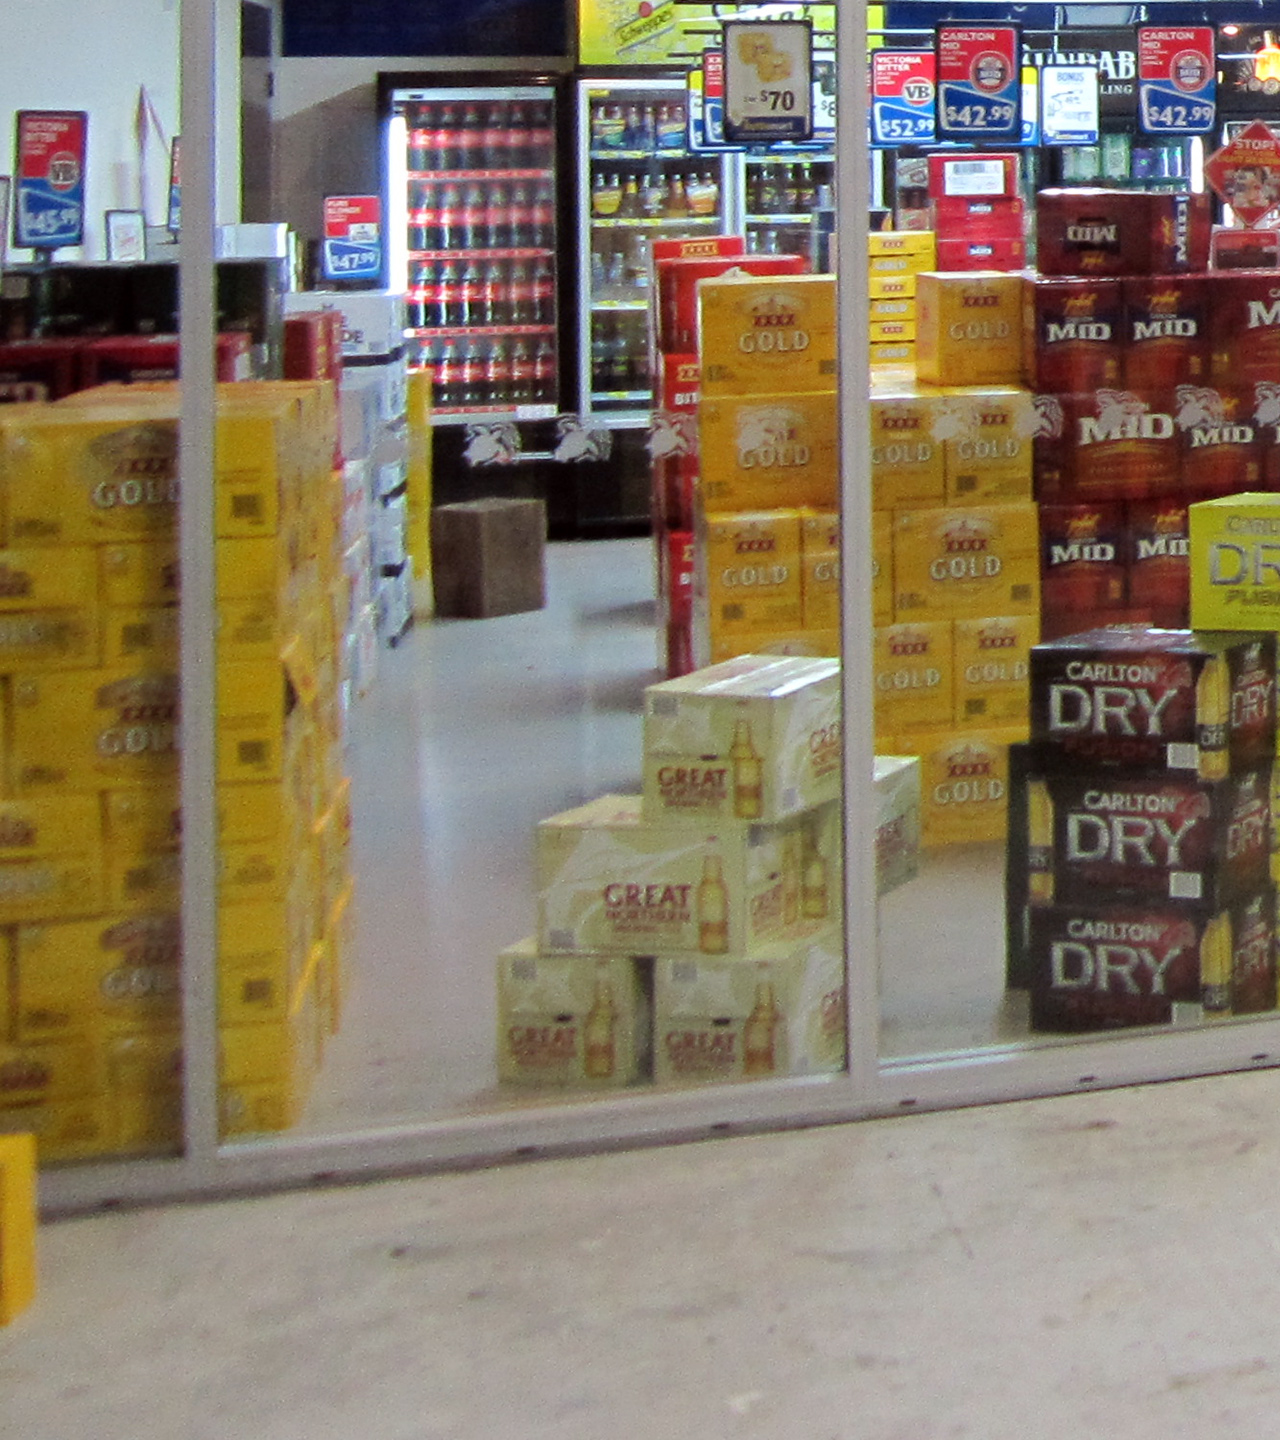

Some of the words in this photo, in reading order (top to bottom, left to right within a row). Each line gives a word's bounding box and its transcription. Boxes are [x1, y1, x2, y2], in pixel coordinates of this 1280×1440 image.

[940, 32, 995, 40] CARLTON
[940, 41, 960, 49] MID
[1141, 31, 1194, 40] CARLTON
[1141, 41, 1160, 49] MID
[877, 56, 922, 64] VICTORIA
[760, 90, 795, 111] $70
[905, 86, 930, 98] VB
[946, 106, 1013, 127] $42.99
[1148, 107, 1213, 127] $42.99
[881, 119, 934, 137] $52.99
[963, 296, 999, 307] XXXX
[753, 314, 795, 327] XXXX
[950, 321, 1009, 340] GOLD
[1133, 317, 1198, 340] MID
[1047, 322, 1112, 342] MID
[738, 333, 810, 353] GOLD
[881, 417, 920, 429] XXXX
[1190, 426, 1254, 447] MID
[738, 445, 811, 469] GOLD
[957, 439, 1020, 460] GOLD
[735, 539, 776, 553] XXXX
[946, 538, 988, 553] XXXX
[1051, 543, 1116, 565] MID
[722, 566, 788, 587] GOLD
[930, 556, 1001, 581] GOLD
[890, 641, 930, 656] XXXX
[979, 633, 1017, 648] XXXX
[876, 668, 941, 690] GOLD
[965, 663, 1028, 683] GOLD
[1066, 662, 1158, 683] CARLTON
[1048, 684, 1178, 736] DRY
[657, 766, 728, 789] GREAT
[947, 761, 990, 777] XXXX
[934, 779, 1005, 805] GOLD
[1084, 791, 1175, 811] CARLTON
[1067, 814, 1196, 866] DRY
[605, 882, 693, 908] GREAT
[1067, 919, 1159, 939] CARLTON
[1051, 942, 1182, 995] DRY
